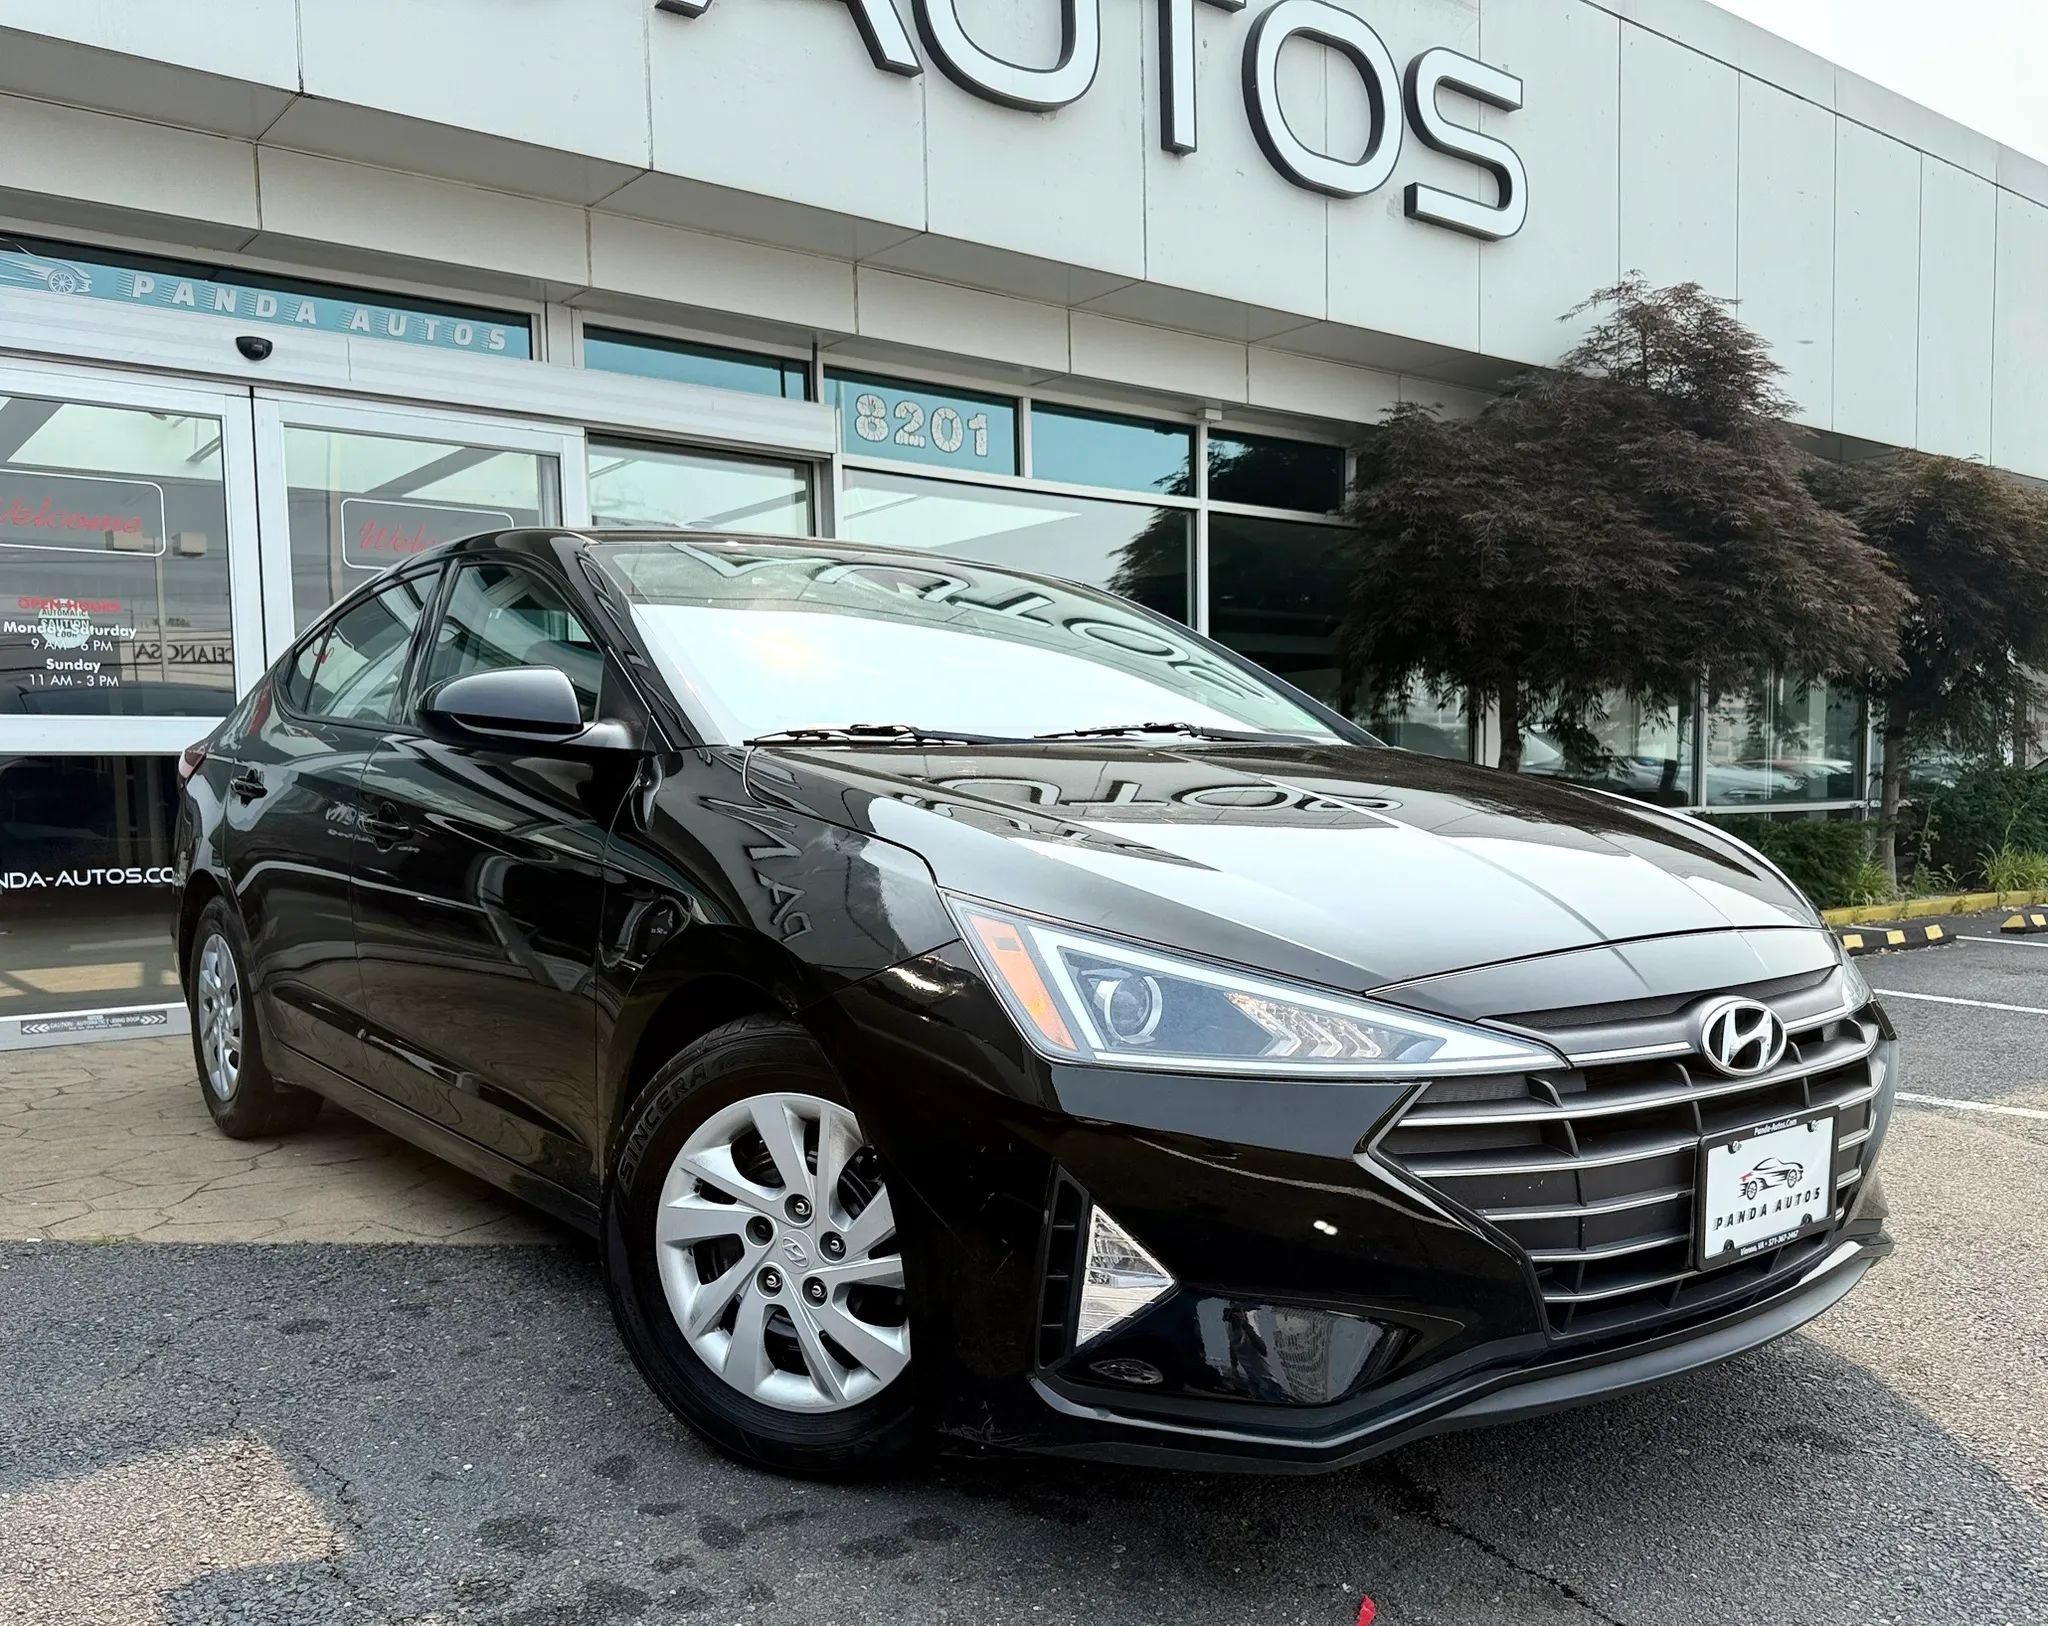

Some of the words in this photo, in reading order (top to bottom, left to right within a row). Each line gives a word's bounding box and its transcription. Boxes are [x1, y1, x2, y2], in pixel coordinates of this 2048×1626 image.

[655, 0, 1527, 241] UTOS
[118, 273, 318, 326] PANDA
[337, 307, 507, 352] AUTOS
[855, 393, 988, 458] 8201
[31, 638, 40, 650] 9
[80, 640, 89, 651] 6
[93, 640, 114, 652] PM
[46, 658, 101, 674] Sunday
[29, 674, 44, 686] 11
[50, 675, 73, 686] AM
[86, 676, 95, 687] 3
[99, 676, 119, 687] PM
[618, 1062, 708, 1186] SINCERA
[1714, 1203, 1768, 1231] PANDA
[1775, 1187, 1821, 1212] AUTOS
